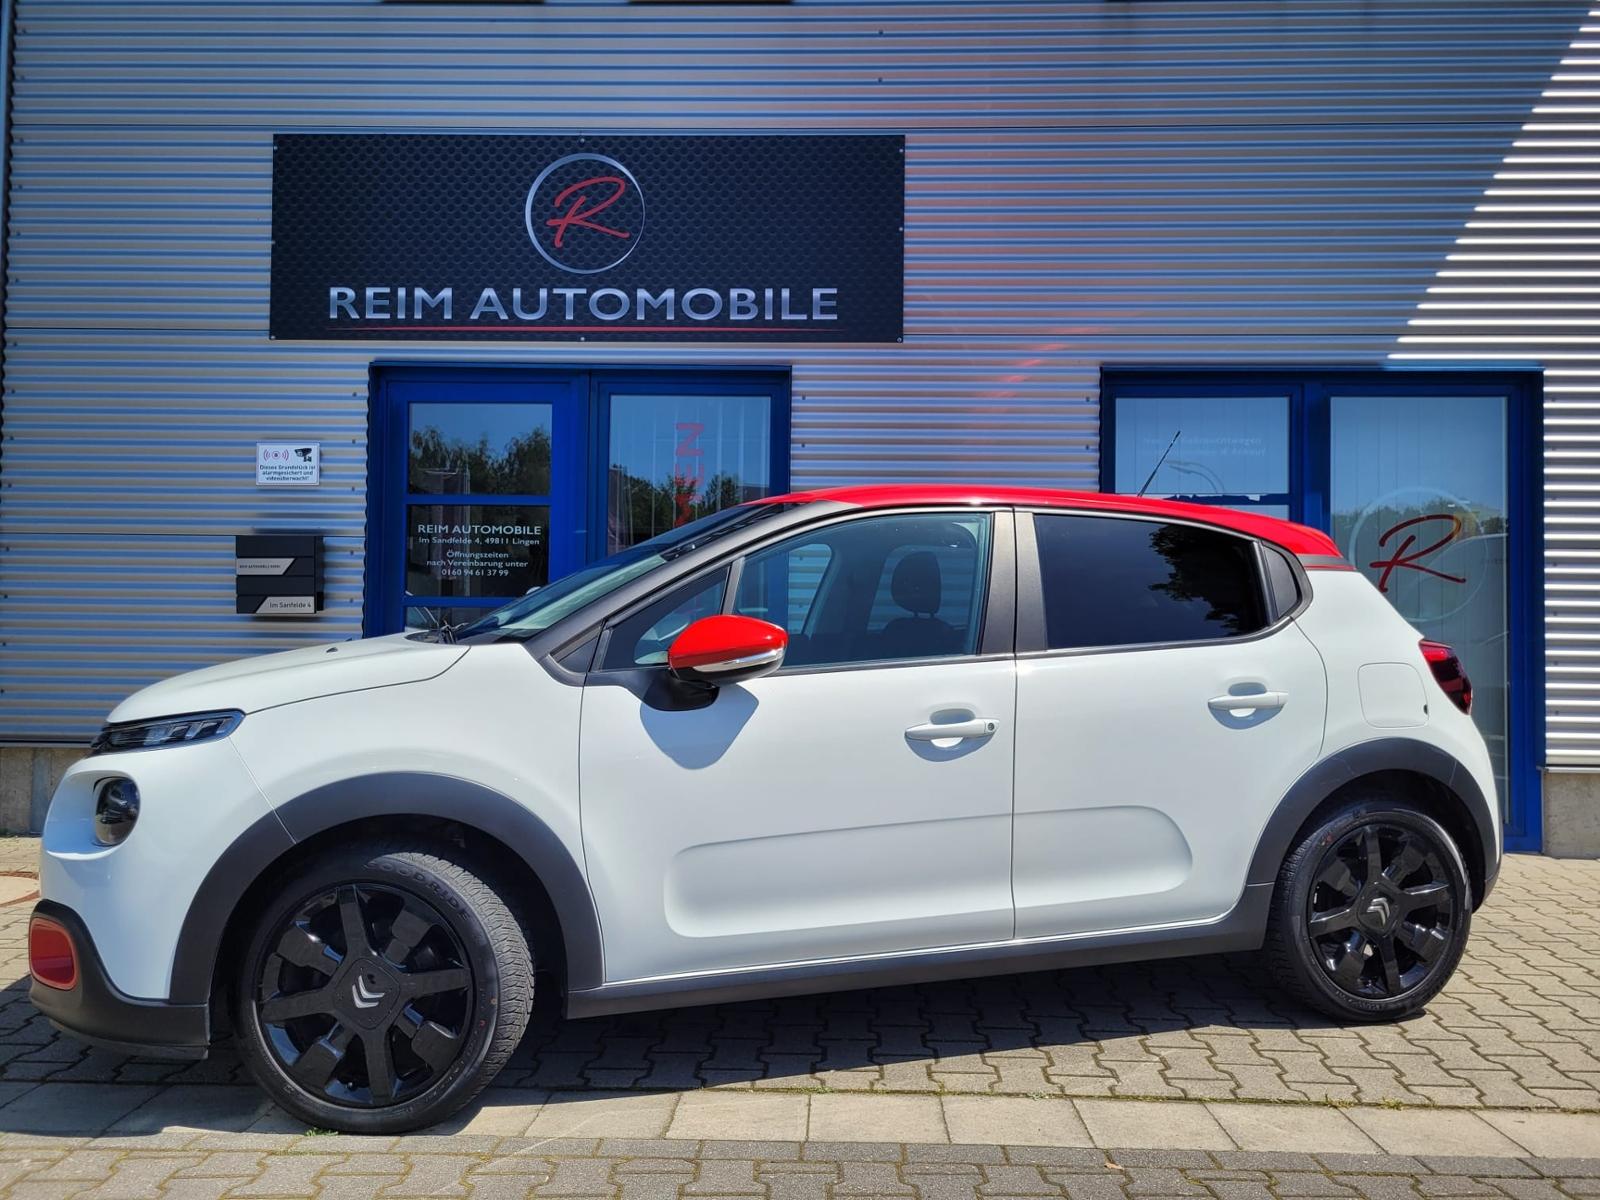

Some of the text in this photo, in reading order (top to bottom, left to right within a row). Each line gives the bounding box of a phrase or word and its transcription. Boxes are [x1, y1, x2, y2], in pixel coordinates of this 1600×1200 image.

[546, 176, 630, 247] R
[328, 286, 839, 321] REIM AUTOMOBILE
[417, 524, 541, 535] REIM AUTOMOBILE
[418, 536, 430, 544] Im
[432, 536, 472, 544] Sandfelde
[484, 537, 509, 545] 49811
[512, 538, 540, 546] Lingen
[446, 549, 509, 559] Öffnungszeiten
[447, 560, 504, 569] Vereinbarung
[441, 568, 462, 576] 0160
[487, 569, 497, 577] 37
[499, 569, 509, 577] 99
[269, 601, 279, 609] Im
